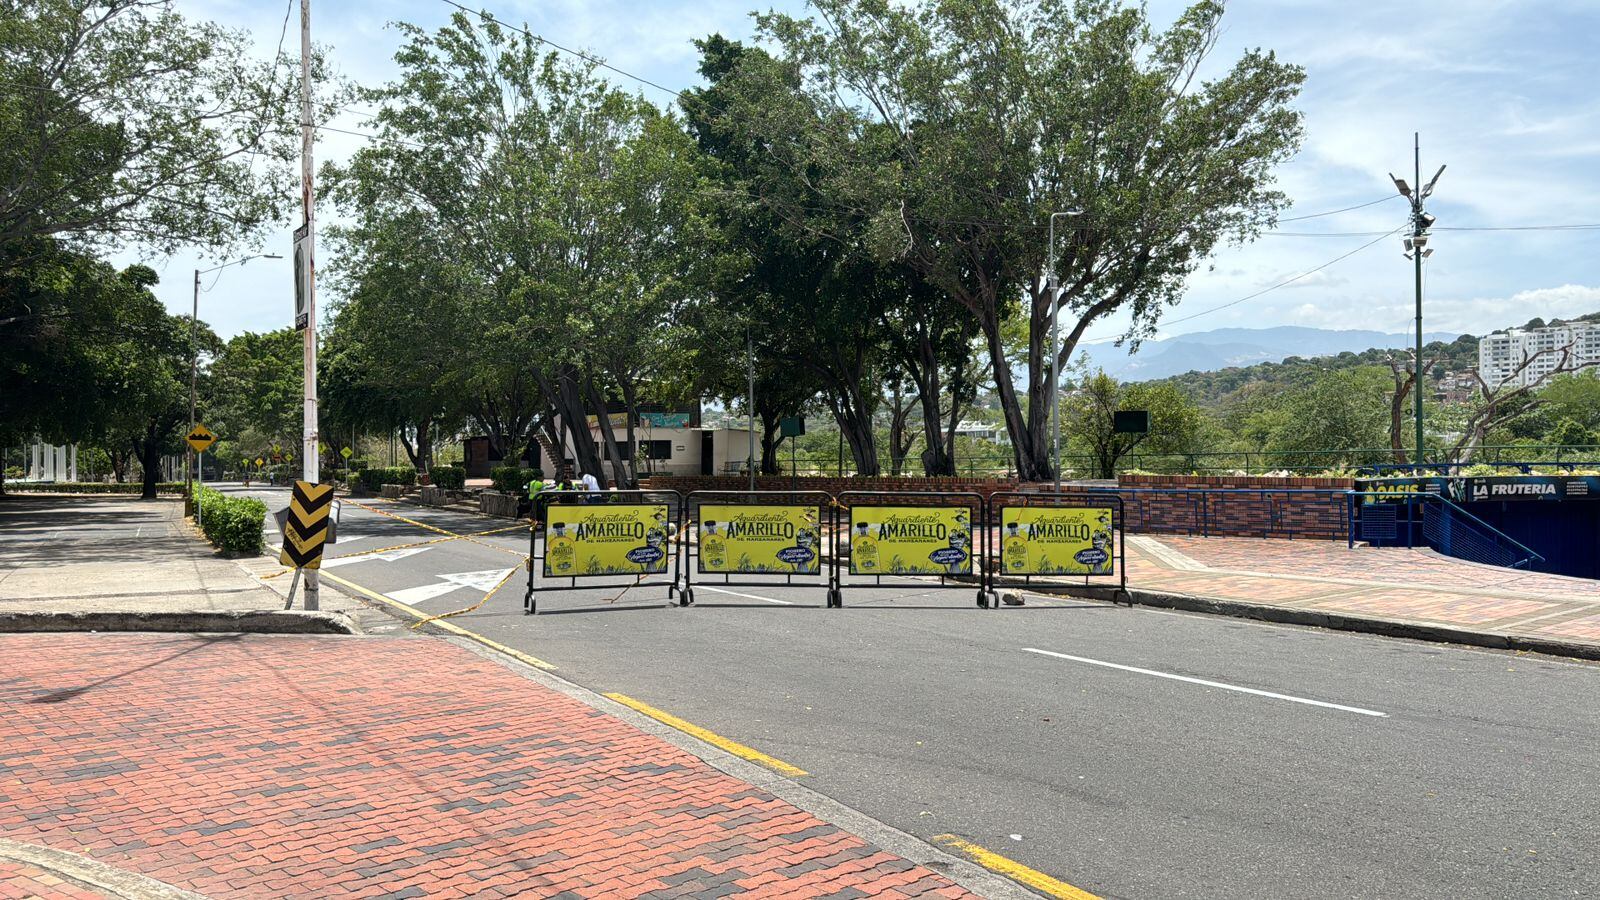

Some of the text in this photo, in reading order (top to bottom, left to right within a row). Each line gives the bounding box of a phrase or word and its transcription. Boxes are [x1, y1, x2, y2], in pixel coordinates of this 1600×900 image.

[1376, 484, 1419, 500] OASIS
[1473, 485, 1488, 496] LA
[1491, 484, 1556, 495] FRUTERIA
[575, 522, 644, 542] AMARILLO
[726, 522, 794, 540] AMARILLO
[877, 523, 946, 541] AMARILLO
[1027, 524, 1090, 541] AMARILLO
